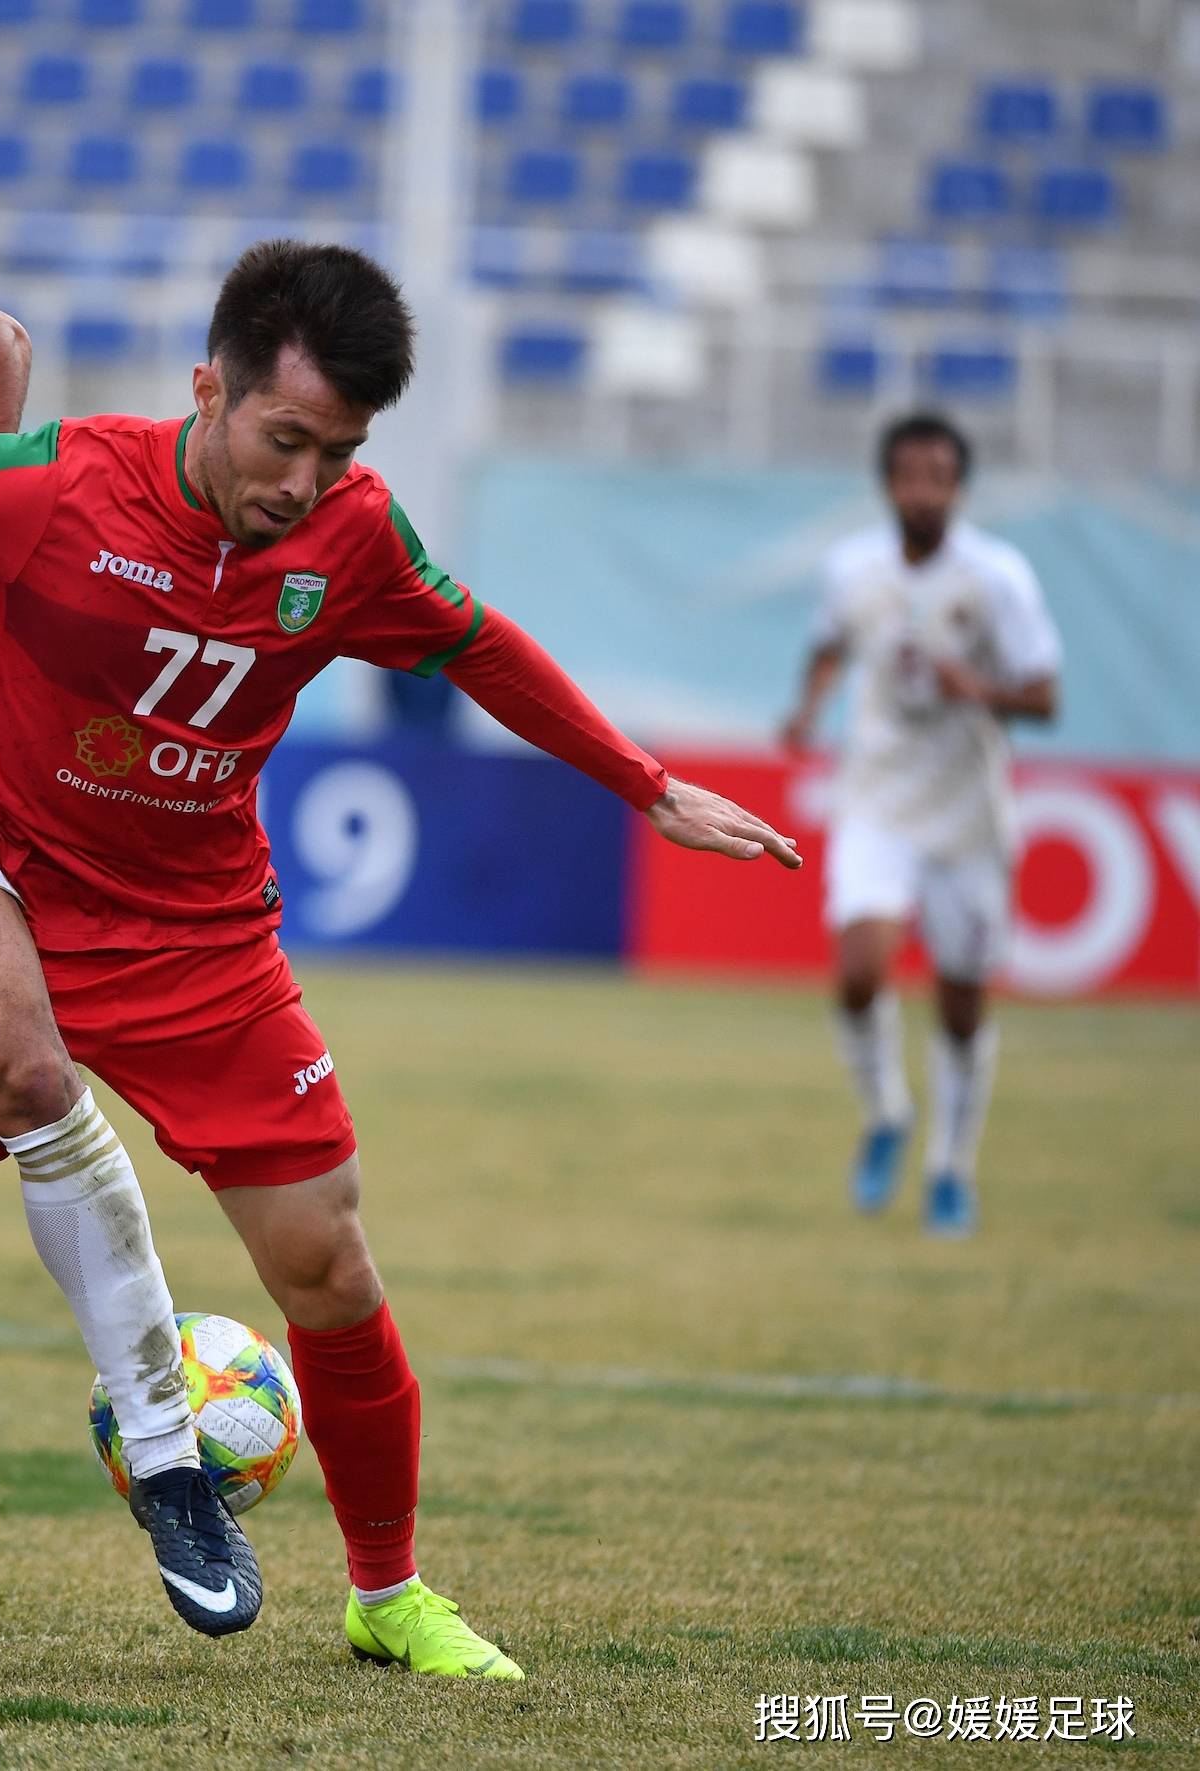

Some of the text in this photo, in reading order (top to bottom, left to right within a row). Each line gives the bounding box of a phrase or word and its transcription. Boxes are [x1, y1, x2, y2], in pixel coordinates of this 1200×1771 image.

[286, 576, 324, 588] LOKOMOTIV
[132, 627, 257, 729] 77
[150, 741, 243, 784] OFB
[293, 1048, 334, 1096] Jom
